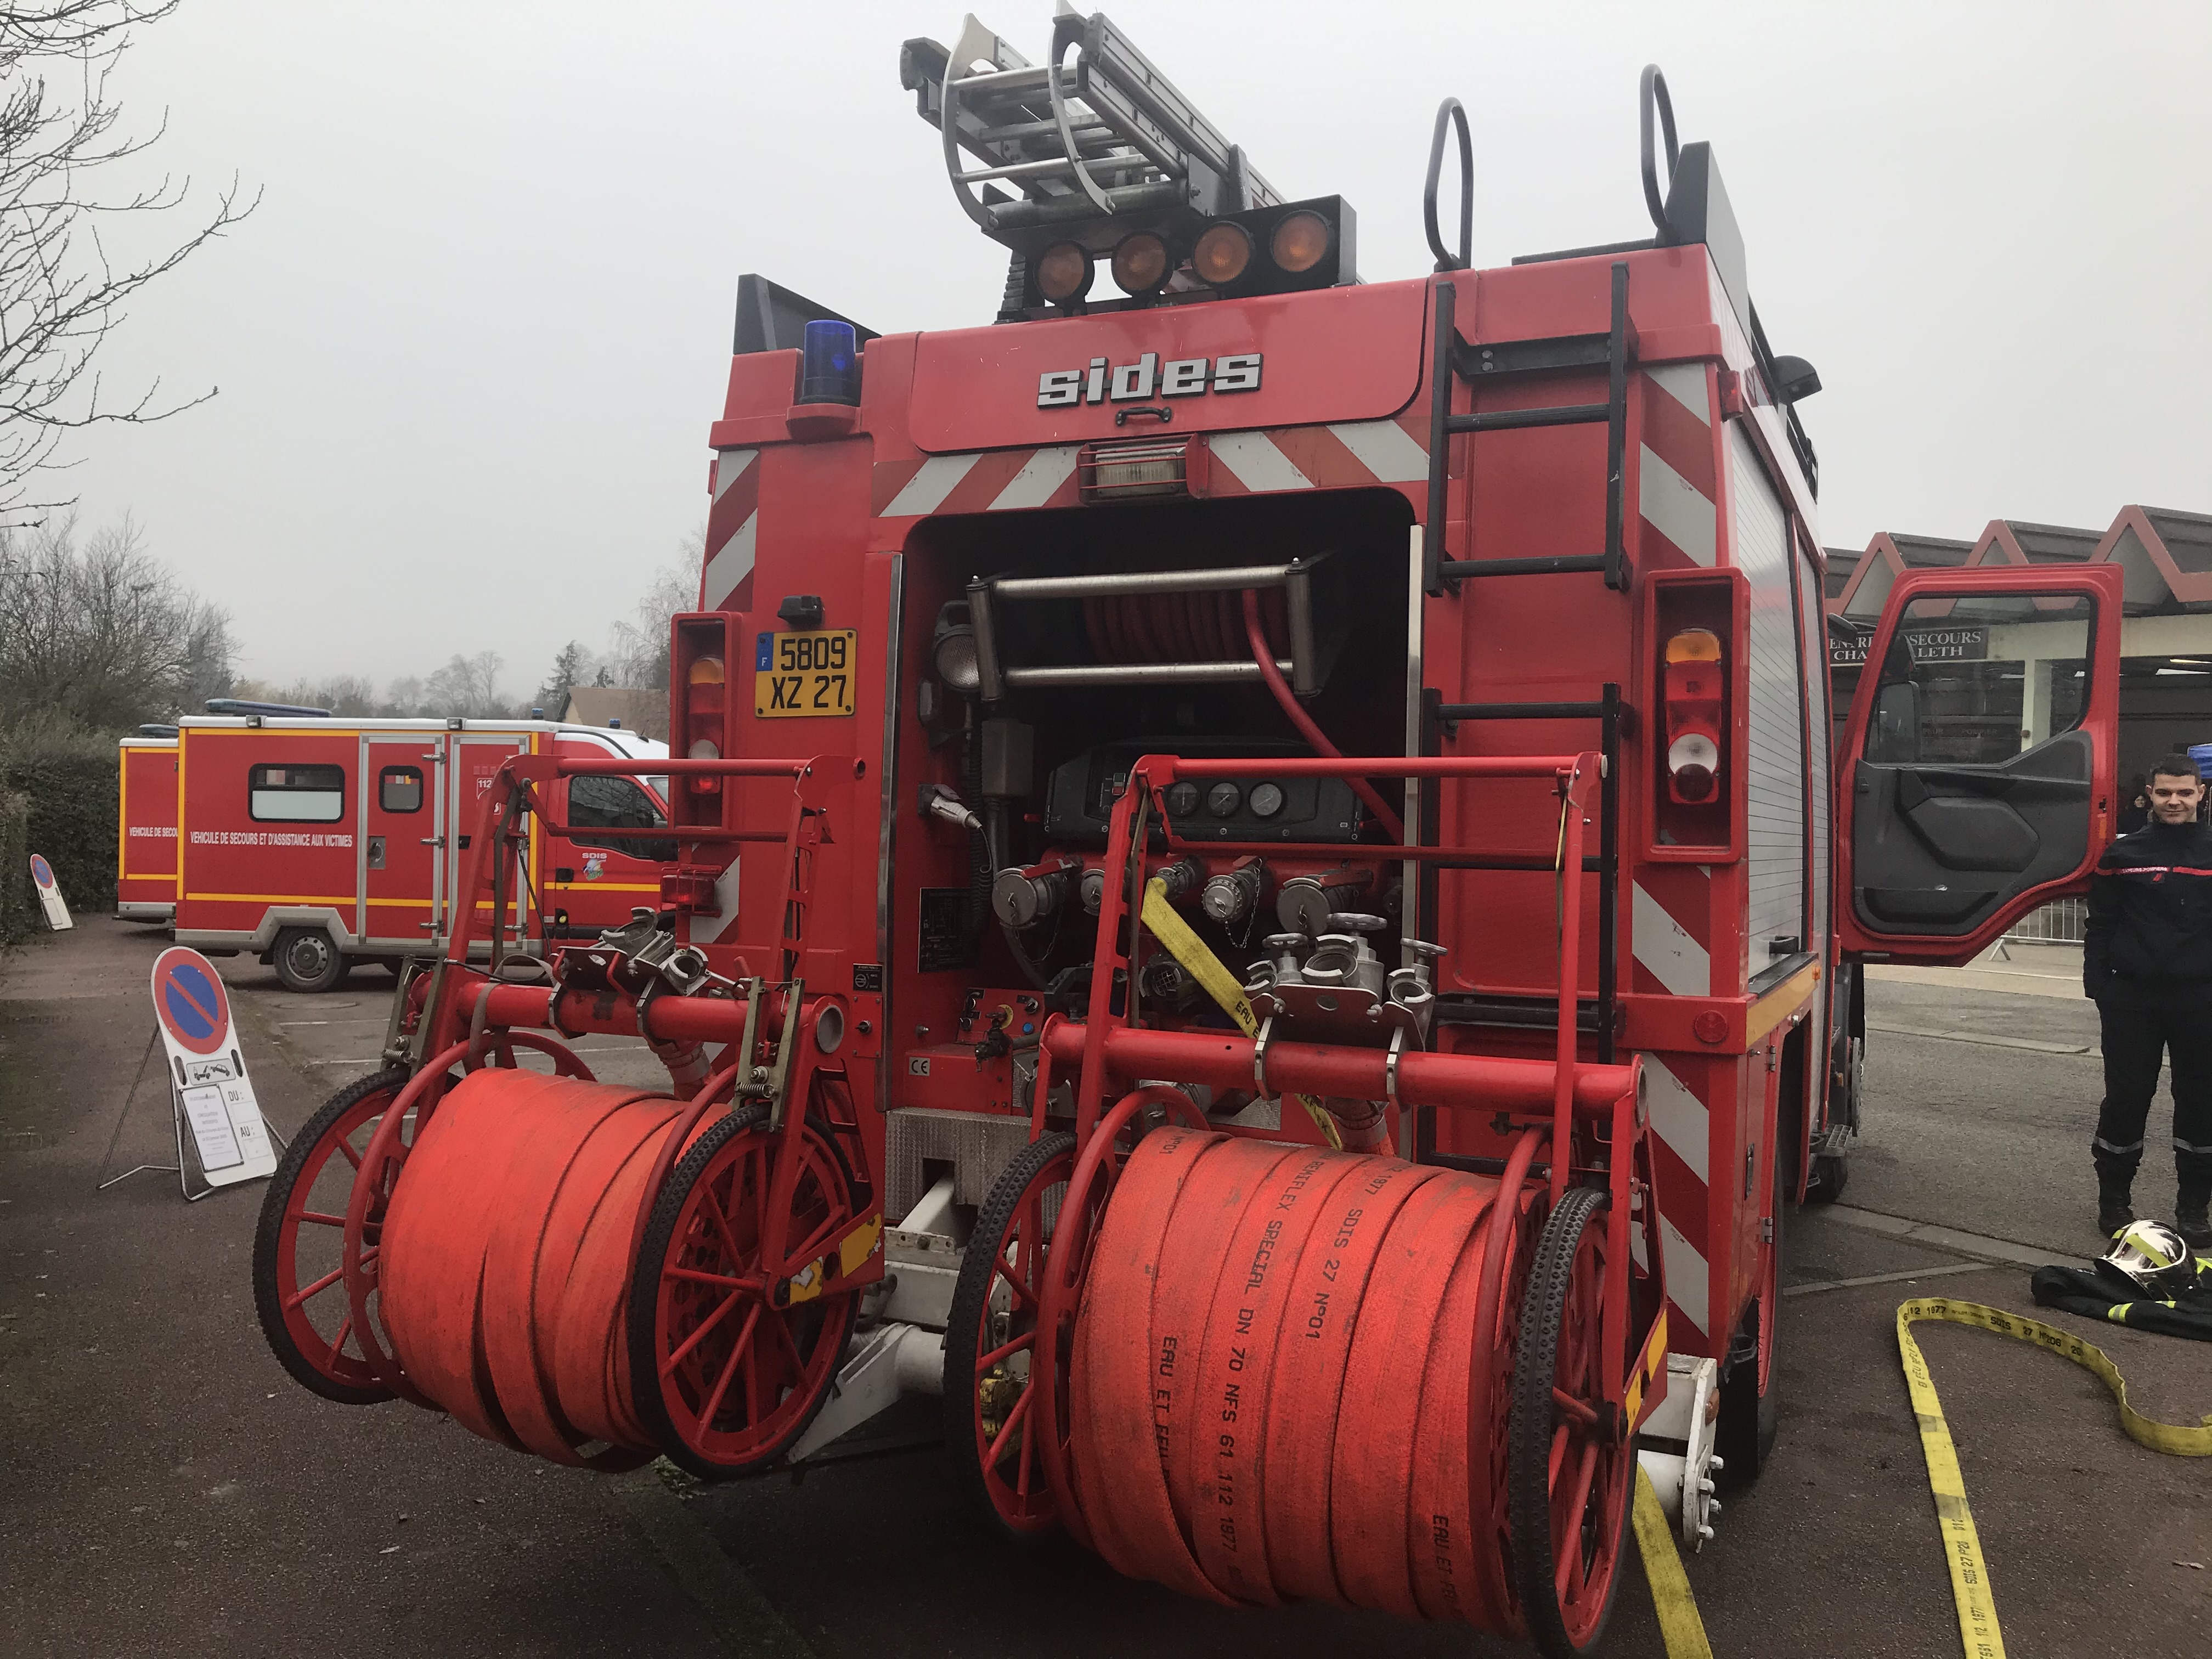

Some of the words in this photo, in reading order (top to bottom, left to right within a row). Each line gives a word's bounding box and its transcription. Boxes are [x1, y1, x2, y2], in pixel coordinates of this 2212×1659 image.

[1037, 352, 1263, 409] sides
[1909, 631, 1981, 646] SECOURS
[761, 657, 768, 667] F
[781, 636, 846, 671] 5809
[1833, 650, 1867, 661] CHA
[1915, 646, 1963, 658] LETH
[770, 676, 803, 709] XZ
[814, 674, 847, 708] 27
[478, 780, 493, 788] 112
[129, 827, 154, 837] VEHICULE
[154, 827, 161, 837] DE
[190, 831, 219, 844] VEHICULE
[220, 832, 228, 844] DE
[229, 832, 258, 845] SECOURS
[259, 833, 268, 845] ET
[268, 833, 310, 846] D'ASSISTANCE
[311, 834, 324, 847] AUX
[325, 834, 353, 847] VICTIMES
[1235, 1000, 1252, 1025] EAU
[1252, 1026, 1261, 1039] E
[911, 1059, 928, 1074] CE
[228, 1090, 239, 1102] DU
[240, 1126, 251, 1137] AU
[1334, 1209, 1363, 1249] SDIS
[1244, 1220, 1283, 1295] SPECIAL
[1323, 1259, 1341, 1282] 27
[1235, 1308, 1254, 1334] DN
[1990, 1317, 2012, 1330] SDIS
[2023, 1325, 2033, 1336] 27
[1160, 1335, 1178, 1377] EAU
[1228, 1347, 1245, 1372] 70
[1156, 1389, 1171, 1413] ET
[1222, 1383, 1240, 1424] NFS
[1432, 1515, 1450, 1550] EAU
[1960, 1556, 1974, 1567] 27
[1962, 1569, 1978, 1584] SDIS
